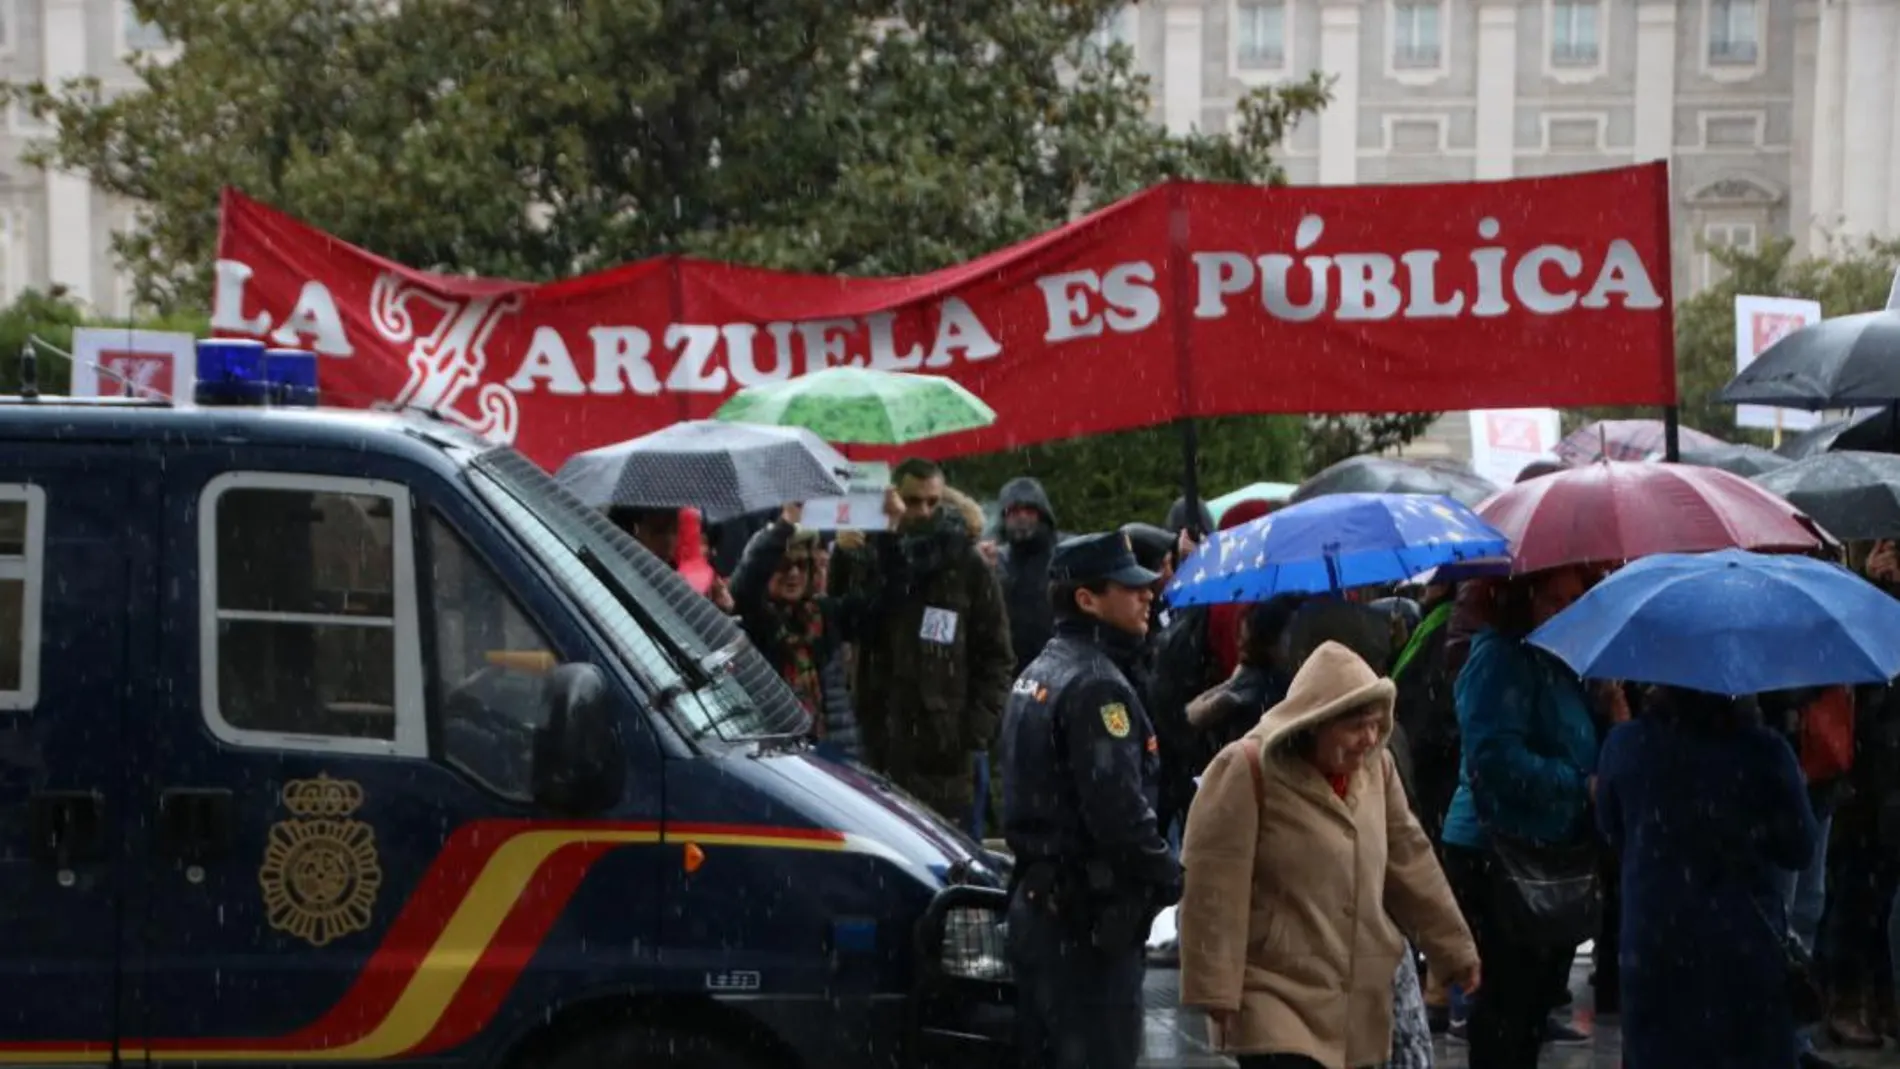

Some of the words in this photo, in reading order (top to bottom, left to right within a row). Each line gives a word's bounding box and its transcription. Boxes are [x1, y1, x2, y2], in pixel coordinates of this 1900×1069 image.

[211, 259, 354, 357] LA
[370, 271, 1002, 448] ZARZUELA
[1036, 261, 1160, 341] ES
